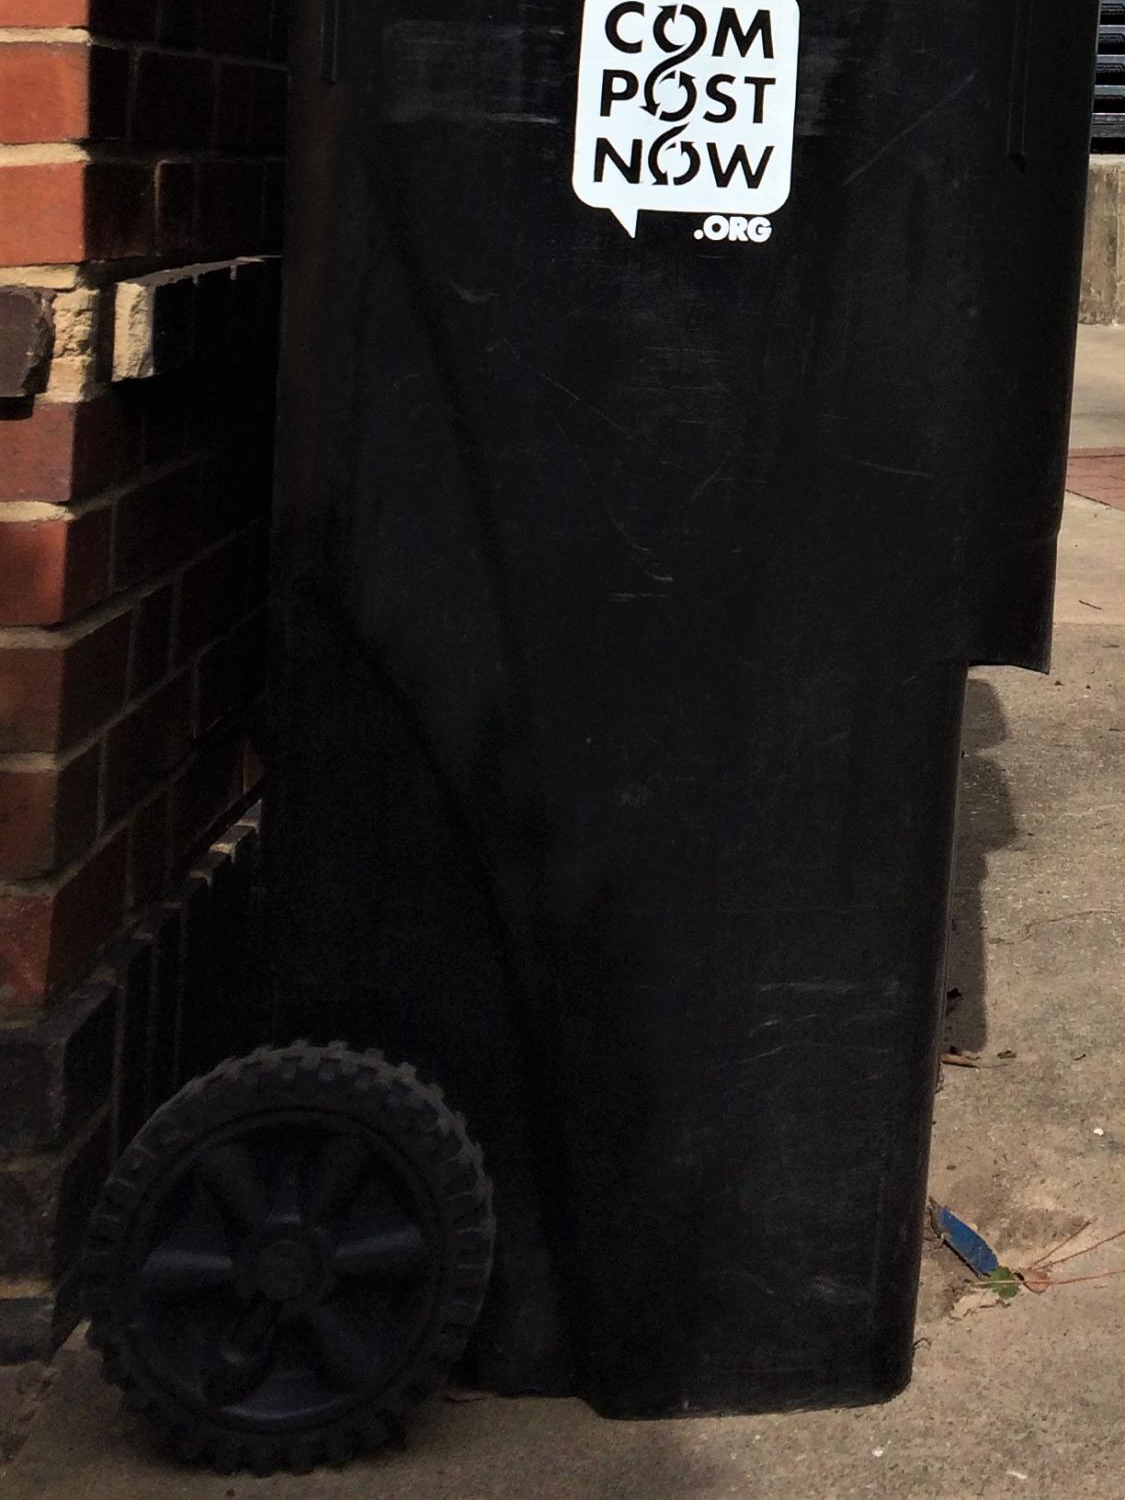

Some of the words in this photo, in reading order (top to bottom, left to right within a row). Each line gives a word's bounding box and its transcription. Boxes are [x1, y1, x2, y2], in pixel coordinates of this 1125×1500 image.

[605, 1, 774, 59] COM
[600, 68, 776, 124] POST
[593, 137, 775, 189] NOW
[694, 215, 772, 243] .ORG
